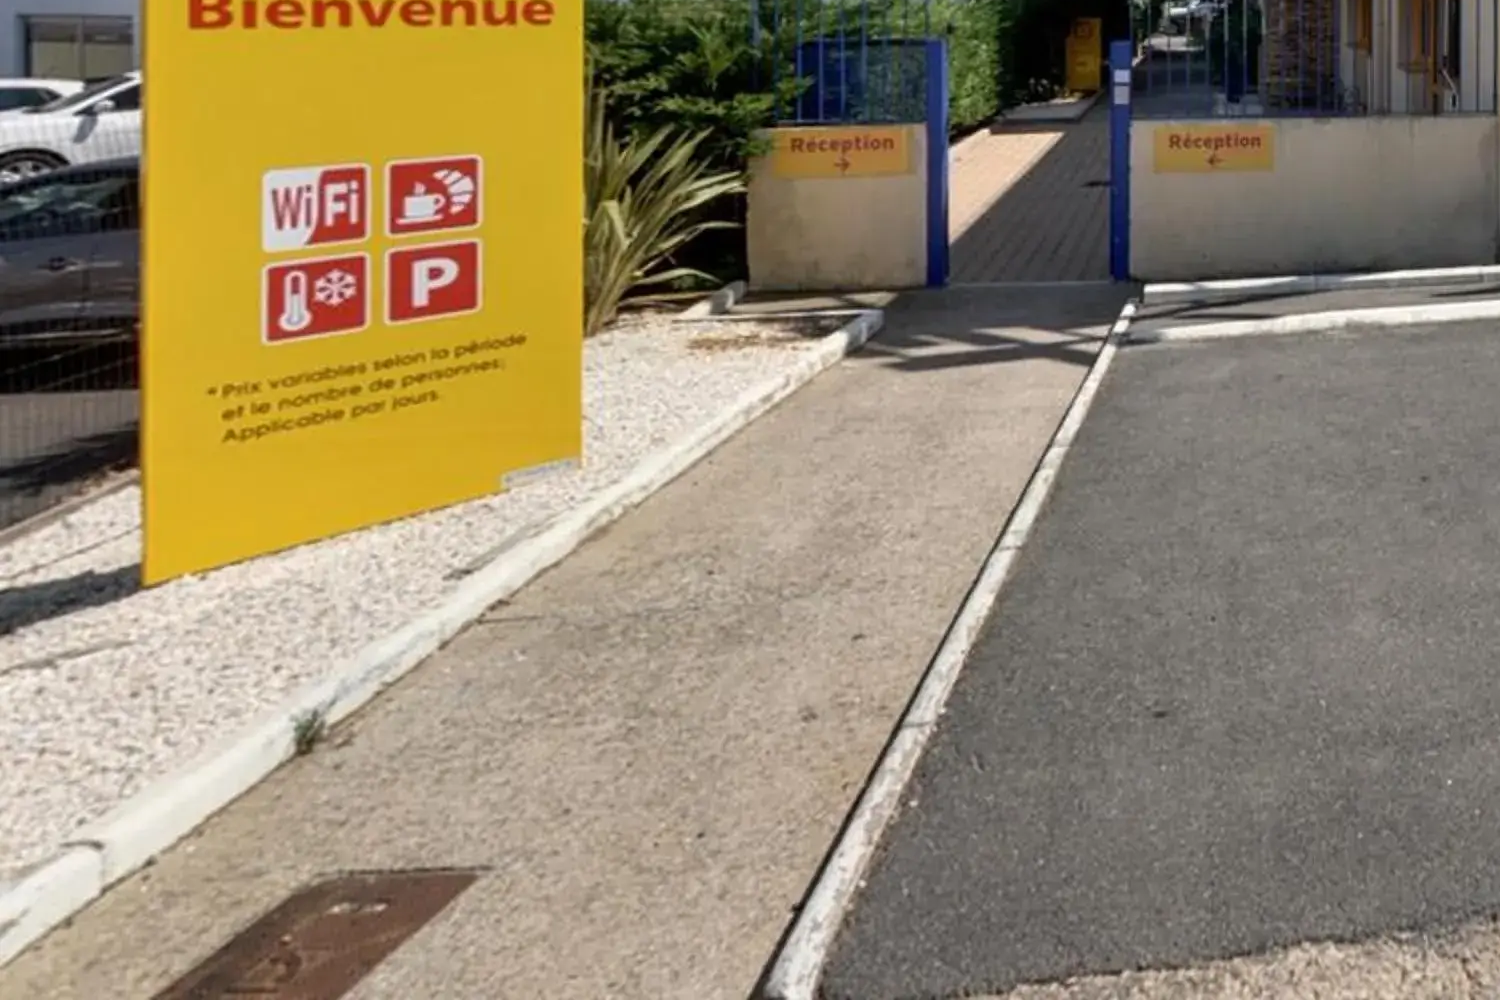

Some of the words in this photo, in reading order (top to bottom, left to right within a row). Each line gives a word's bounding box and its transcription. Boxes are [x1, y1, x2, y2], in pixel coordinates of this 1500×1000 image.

[789, 134, 895, 154] Réception
[1168, 132, 1262, 151] Réception
[271, 180, 359, 231] WiFi
[411, 257, 459, 308] P
[221, 381, 262, 399] Prix
[267, 362, 367, 389] variables
[373, 351, 427, 372] selon
[430, 347, 450, 361] la
[454, 333, 528, 359] période
[220, 404, 244, 422] et
[250, 400, 272, 415] le
[277, 385, 363, 412] nombre
[368, 377, 396, 394] de
[221, 408, 345, 444] Applicable
[352, 399, 387, 419] par
